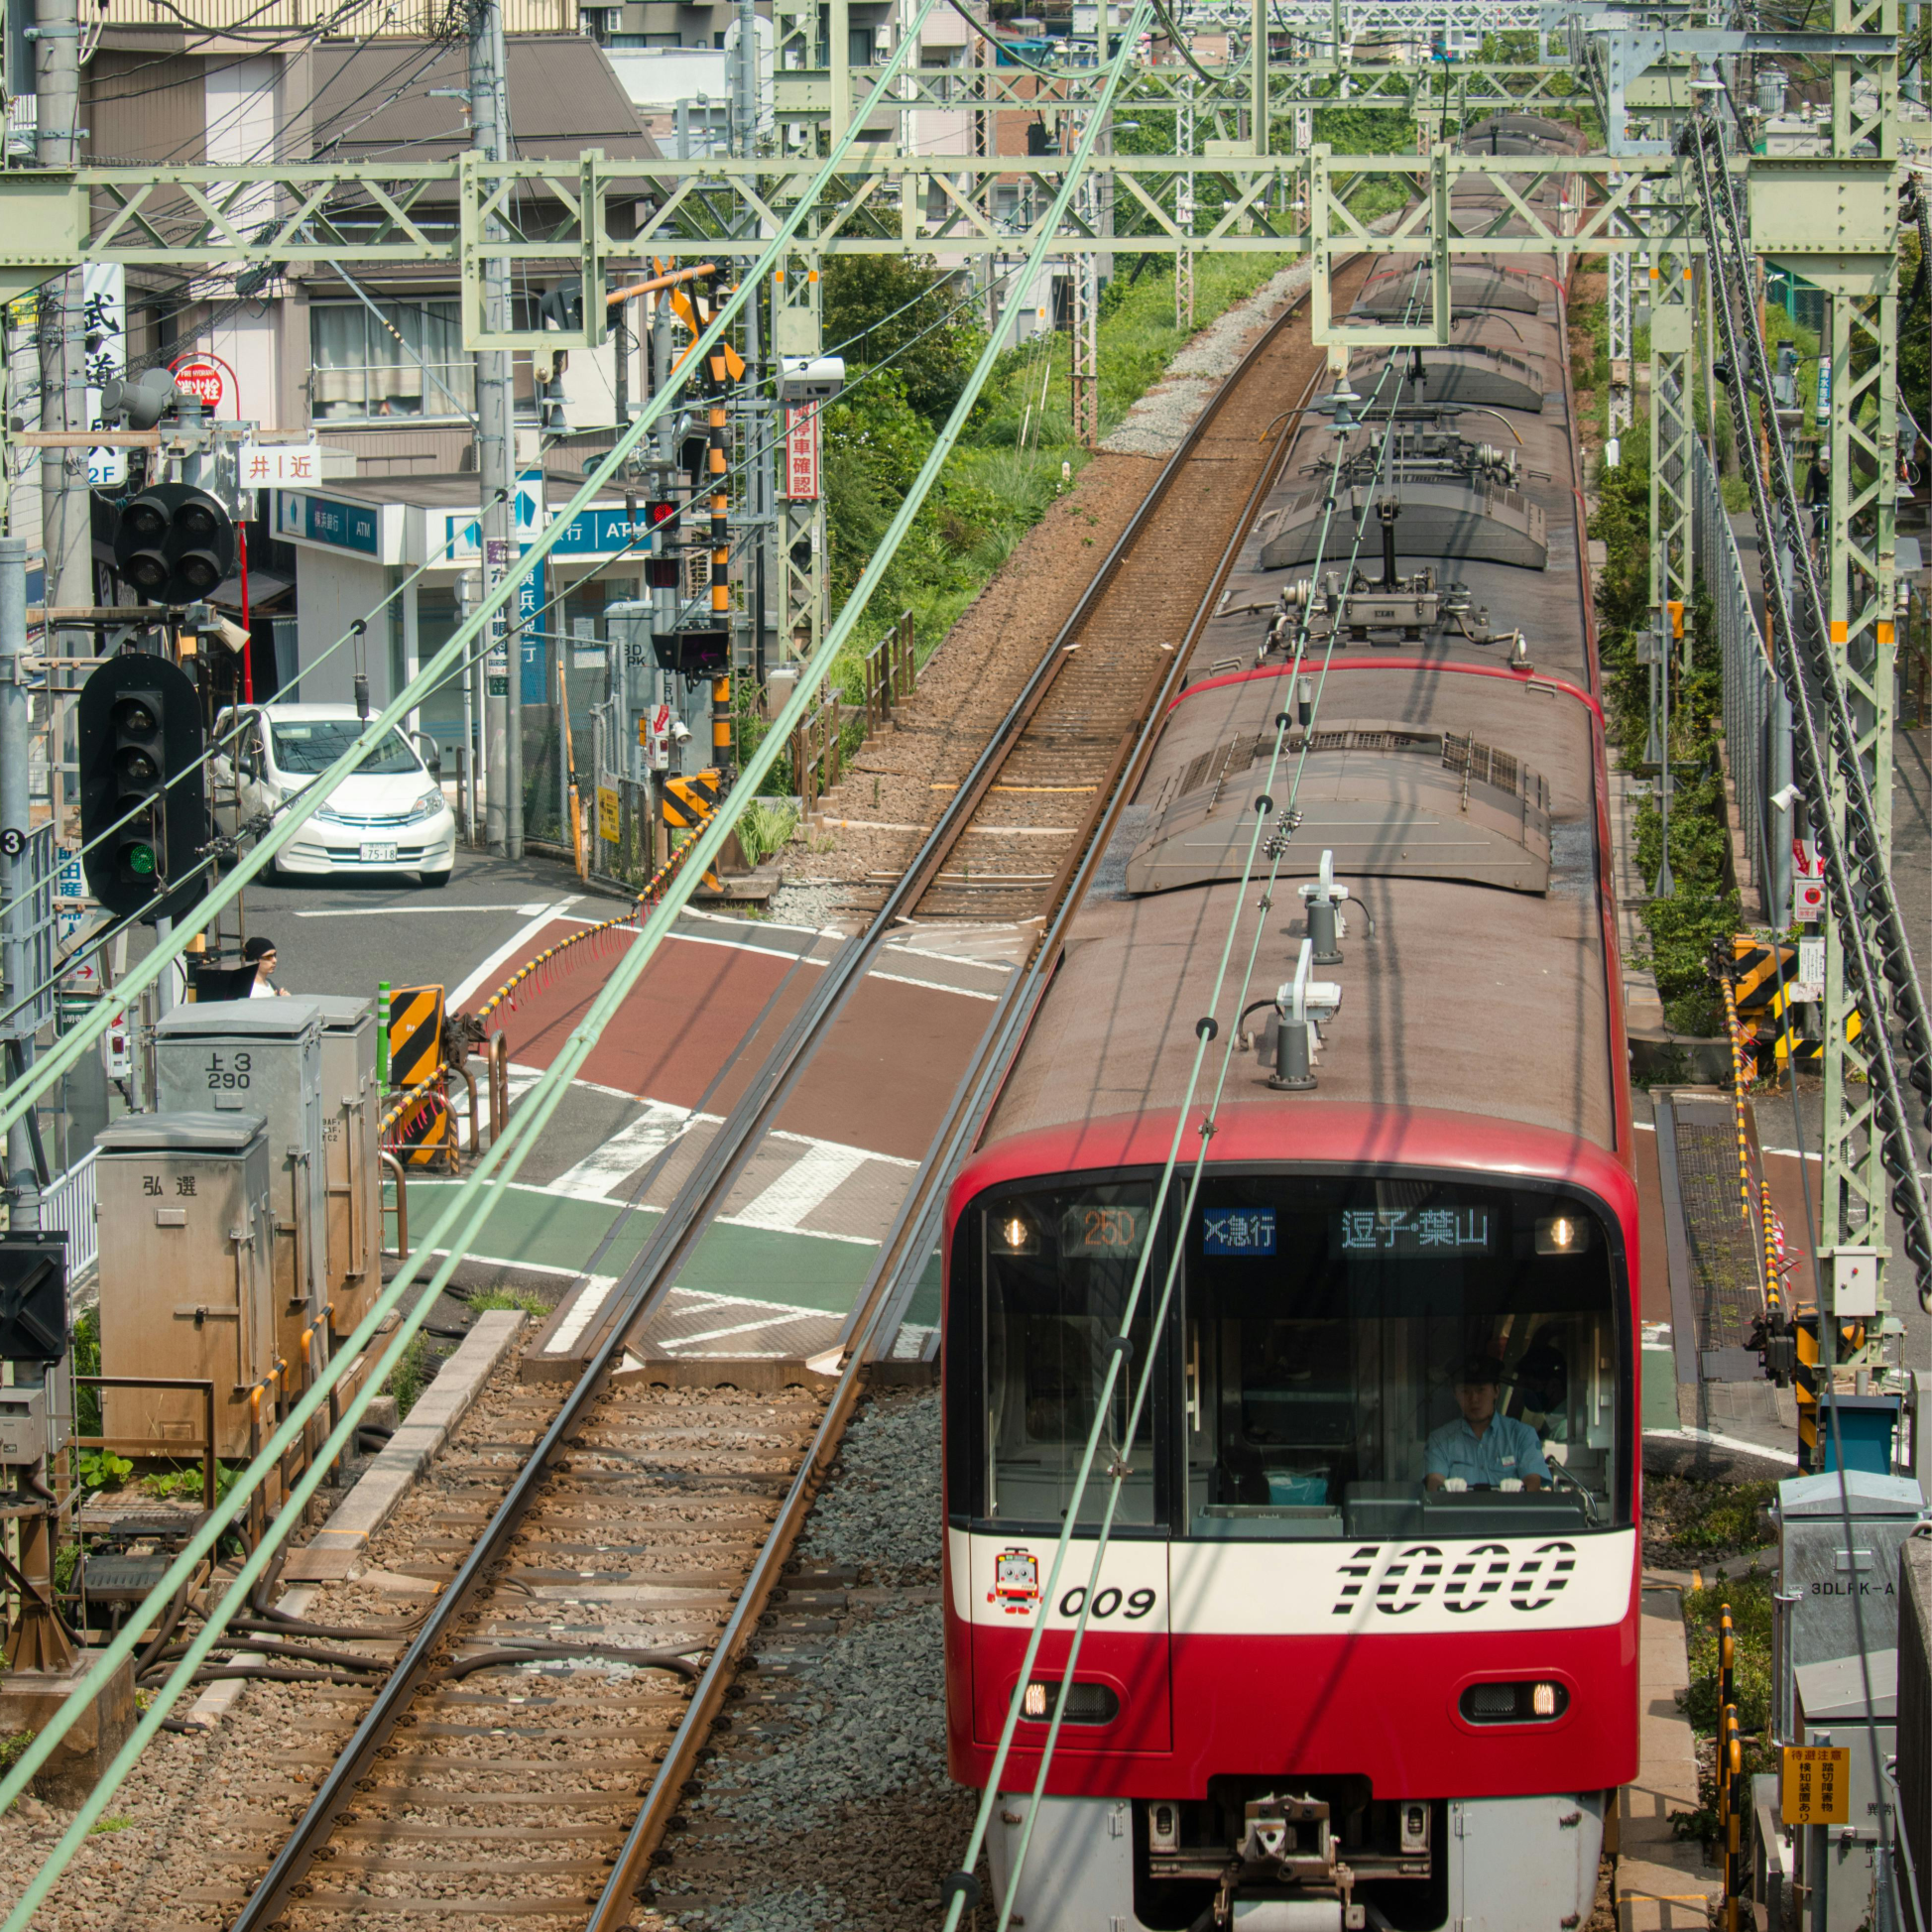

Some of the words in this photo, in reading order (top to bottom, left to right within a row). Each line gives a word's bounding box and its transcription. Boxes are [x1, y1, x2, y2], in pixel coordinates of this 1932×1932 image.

[88, 466, 115, 483] 2F
[356, 521, 371, 539] ATM
[5, 831, 20, 852] 3
[368, 849, 395, 860] 75-18
[207, 1073, 251, 1090] 290
[1085, 1210, 1135, 1246] 25D
[1331, 1541, 1577, 1616] 1000
[1058, 1585, 1156, 1621] 009
[1791, 1750, 1843, 1761] 待避注意
[1798, 1762, 1812, 1823] 検知装置あり
[1821, 1762, 1835, 1813] 踏切障害物
